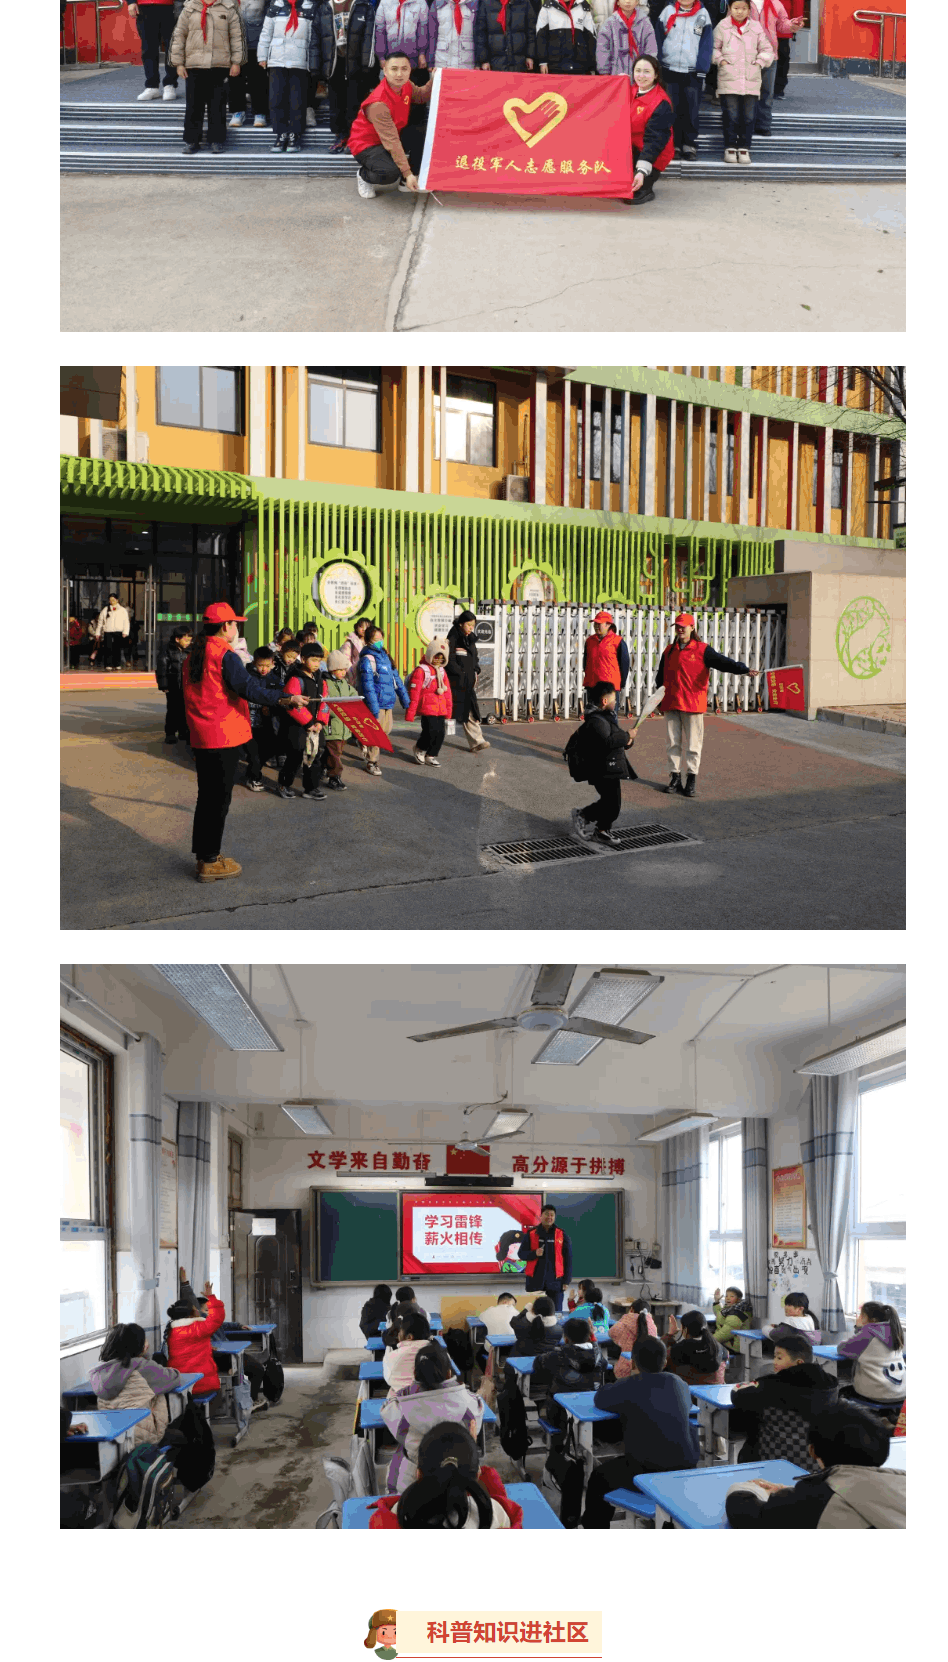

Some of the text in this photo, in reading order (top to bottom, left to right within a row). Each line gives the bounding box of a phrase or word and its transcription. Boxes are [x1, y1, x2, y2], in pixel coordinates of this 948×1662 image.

[455, 154, 612, 175] 退役军人志愿服务队
[307, 1150, 626, 1176] 文学来自勤奋 高分源于拼搏
[424, 1214, 483, 1229] 学习雷锋
[424, 1231, 483, 1246] 薪火相传
